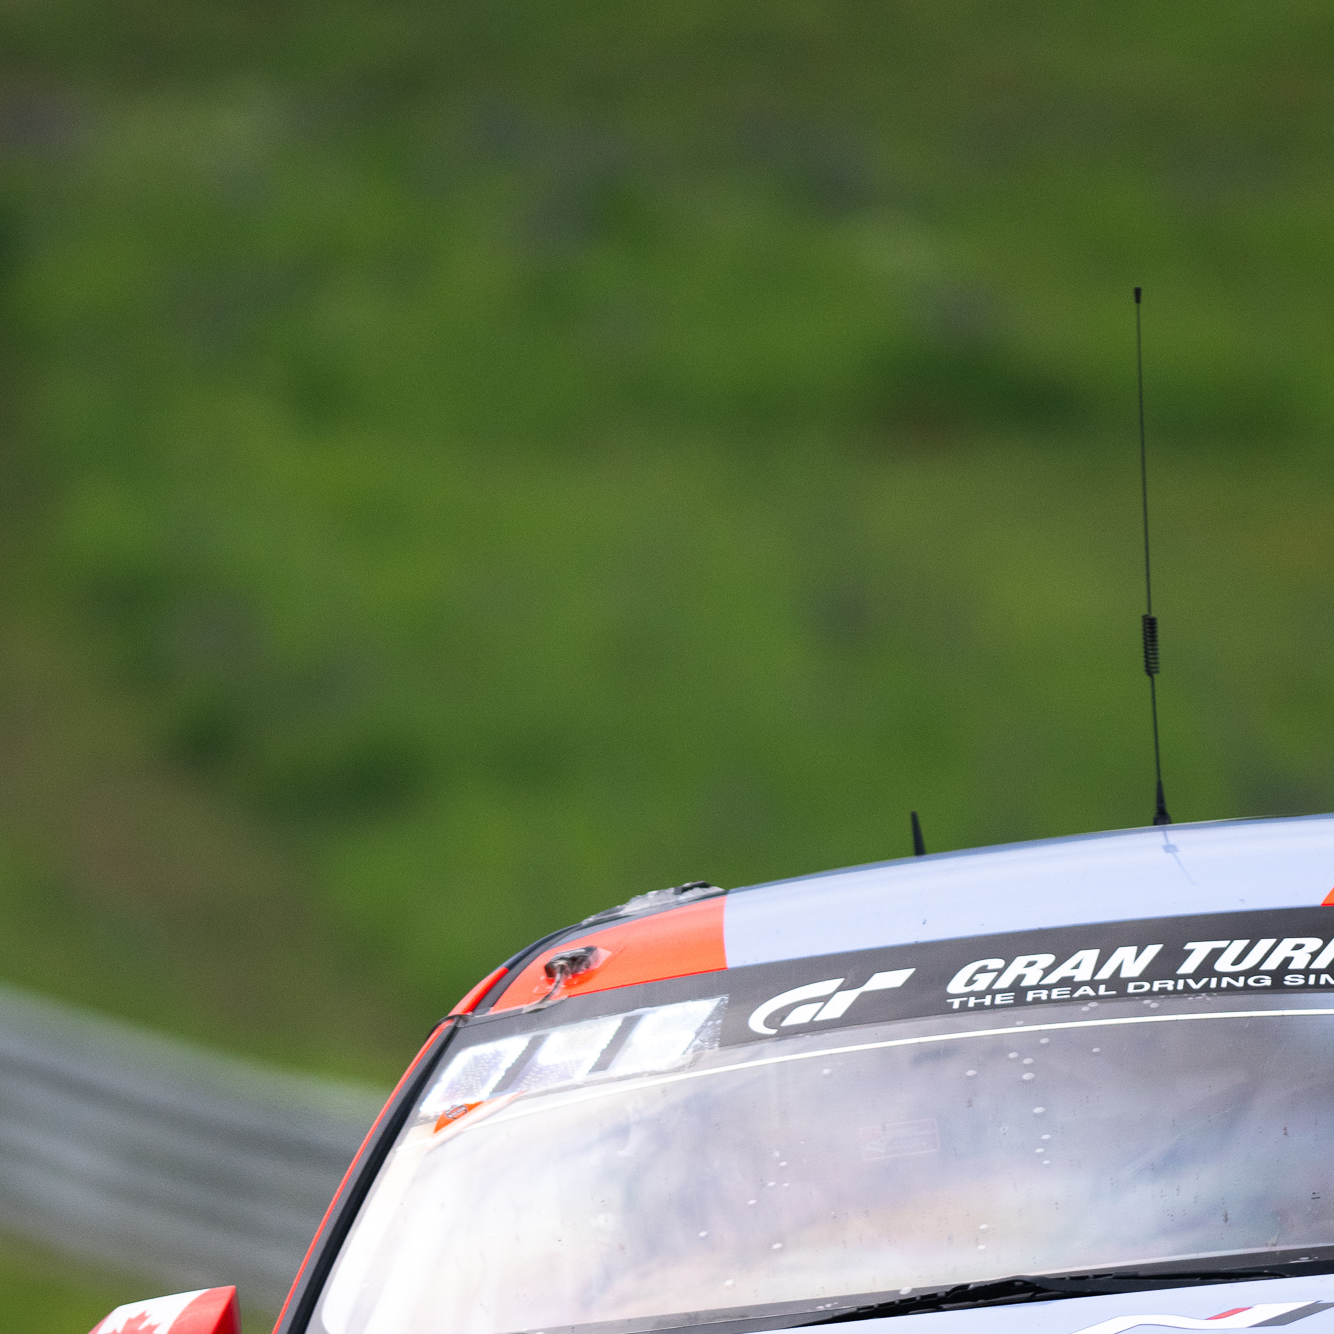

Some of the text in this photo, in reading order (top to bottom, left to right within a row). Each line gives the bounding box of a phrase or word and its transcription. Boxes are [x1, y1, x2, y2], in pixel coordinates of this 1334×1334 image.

[946, 944, 1164, 994] GRAN
[947, 995, 1016, 1010] THE
[1026, 985, 1115, 1003] REAL
[1127, 975, 1273, 993] DRIVING
